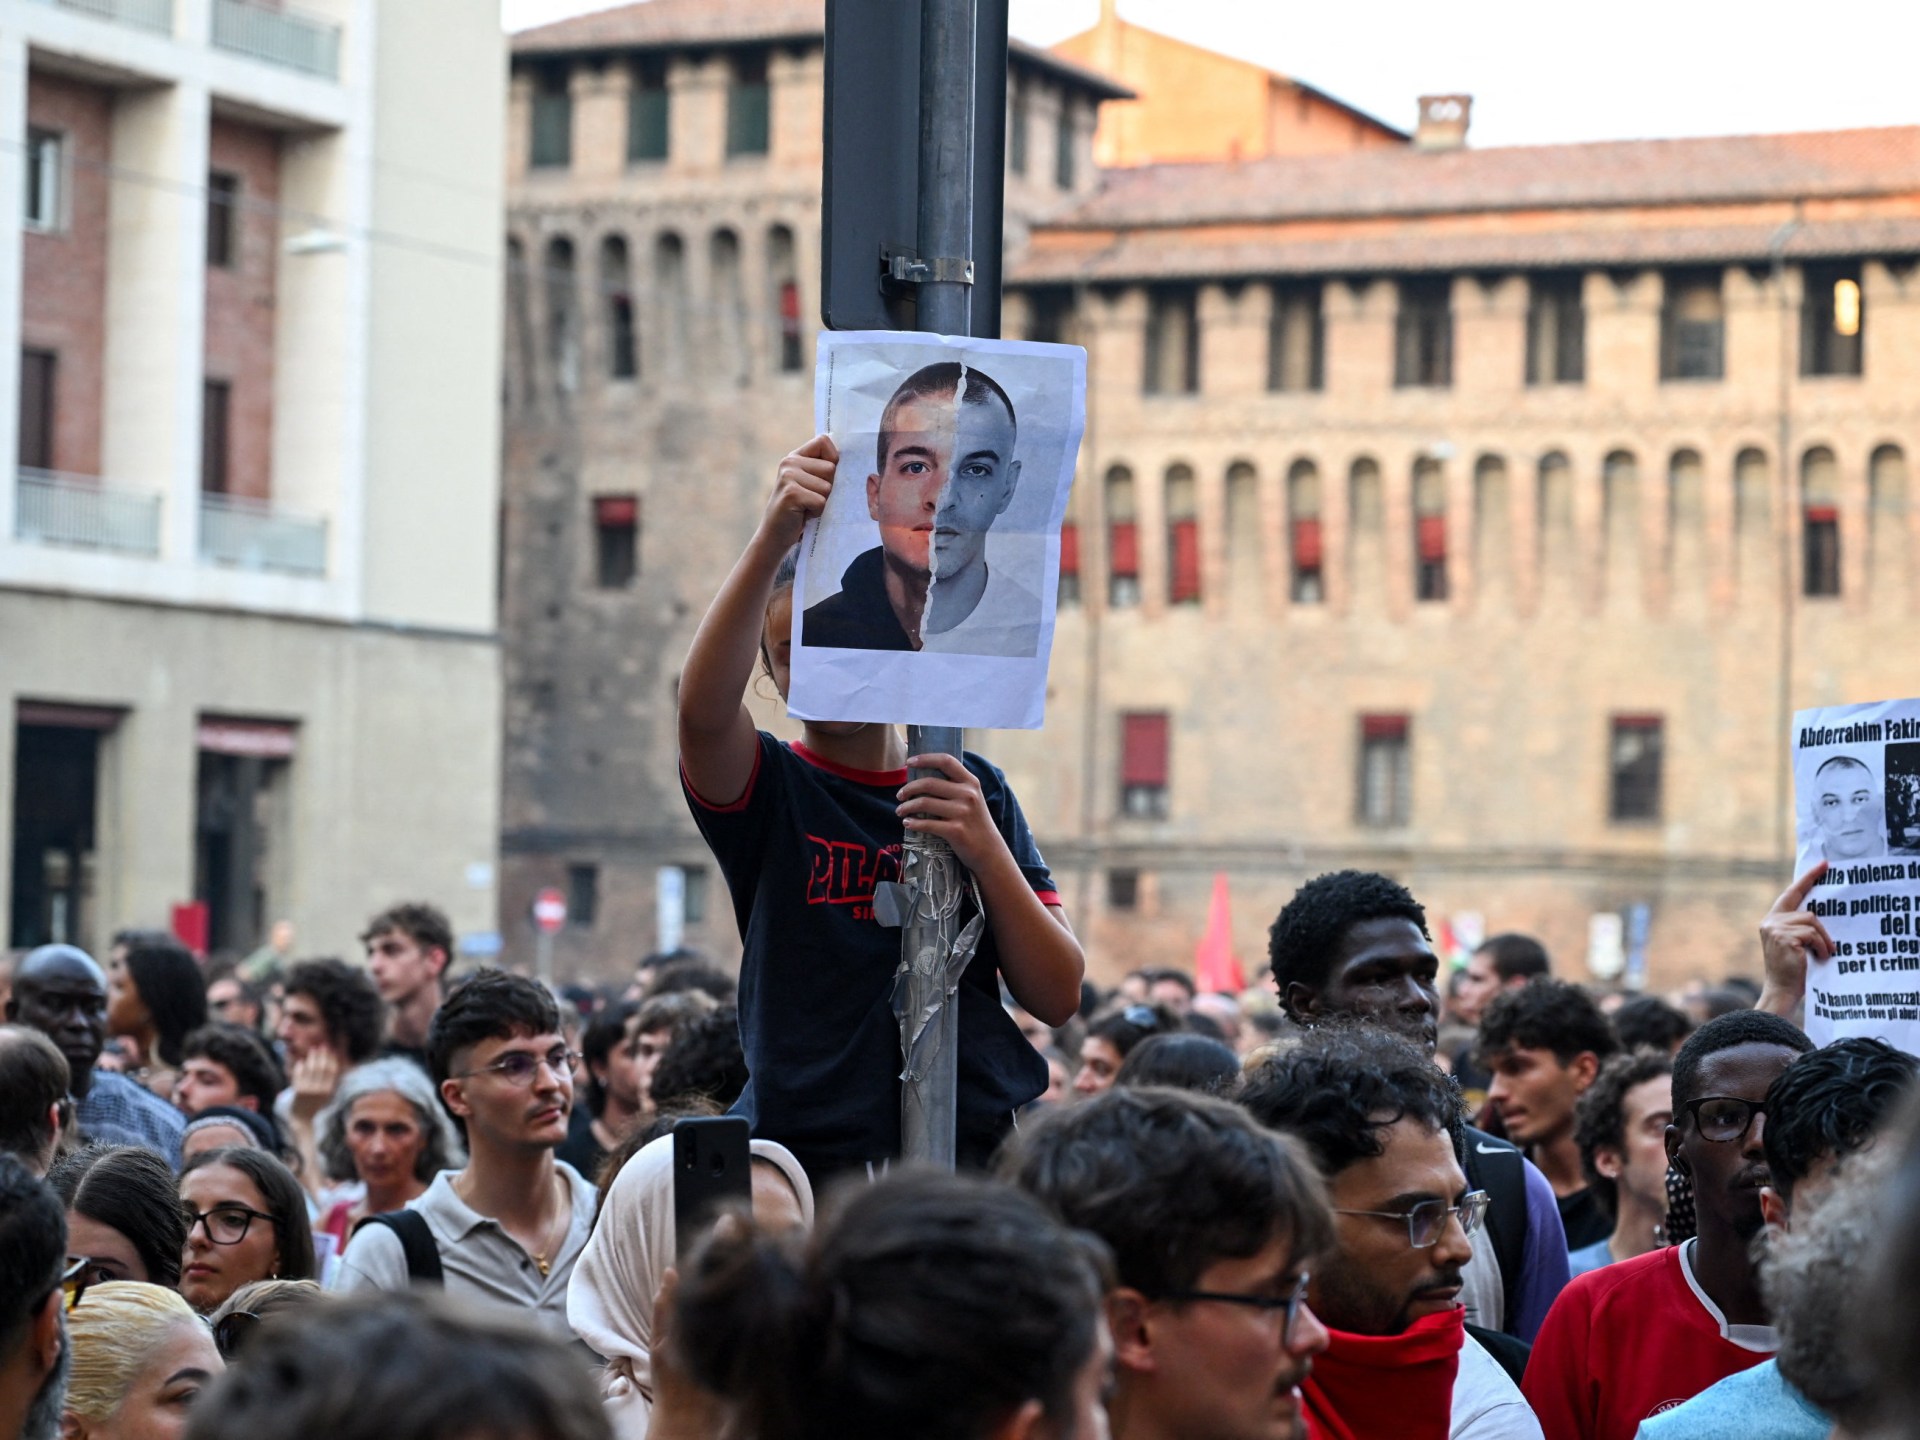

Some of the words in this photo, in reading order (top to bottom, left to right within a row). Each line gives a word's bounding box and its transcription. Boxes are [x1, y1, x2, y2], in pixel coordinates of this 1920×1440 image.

[1799, 721, 1882, 749] Abderrahim
[1847, 863, 1905, 885] violenza
[1807, 898, 1847, 917] dalla
[1850, 893, 1911, 917] politica
[1881, 913, 1910, 936] del
[1856, 941, 1888, 955] sue
[1892, 937, 1920, 954] leg
[1838, 959, 1866, 975] per
[1870, 957, 1876, 972] i
[1880, 956, 1920, 971] crim
[1827, 992, 1863, 1007] hanno
[1830, 1008, 1867, 1021] quartiere
[1868, 1007, 1887, 1020] dove
[1887, 1006, 1898, 1021] gli
